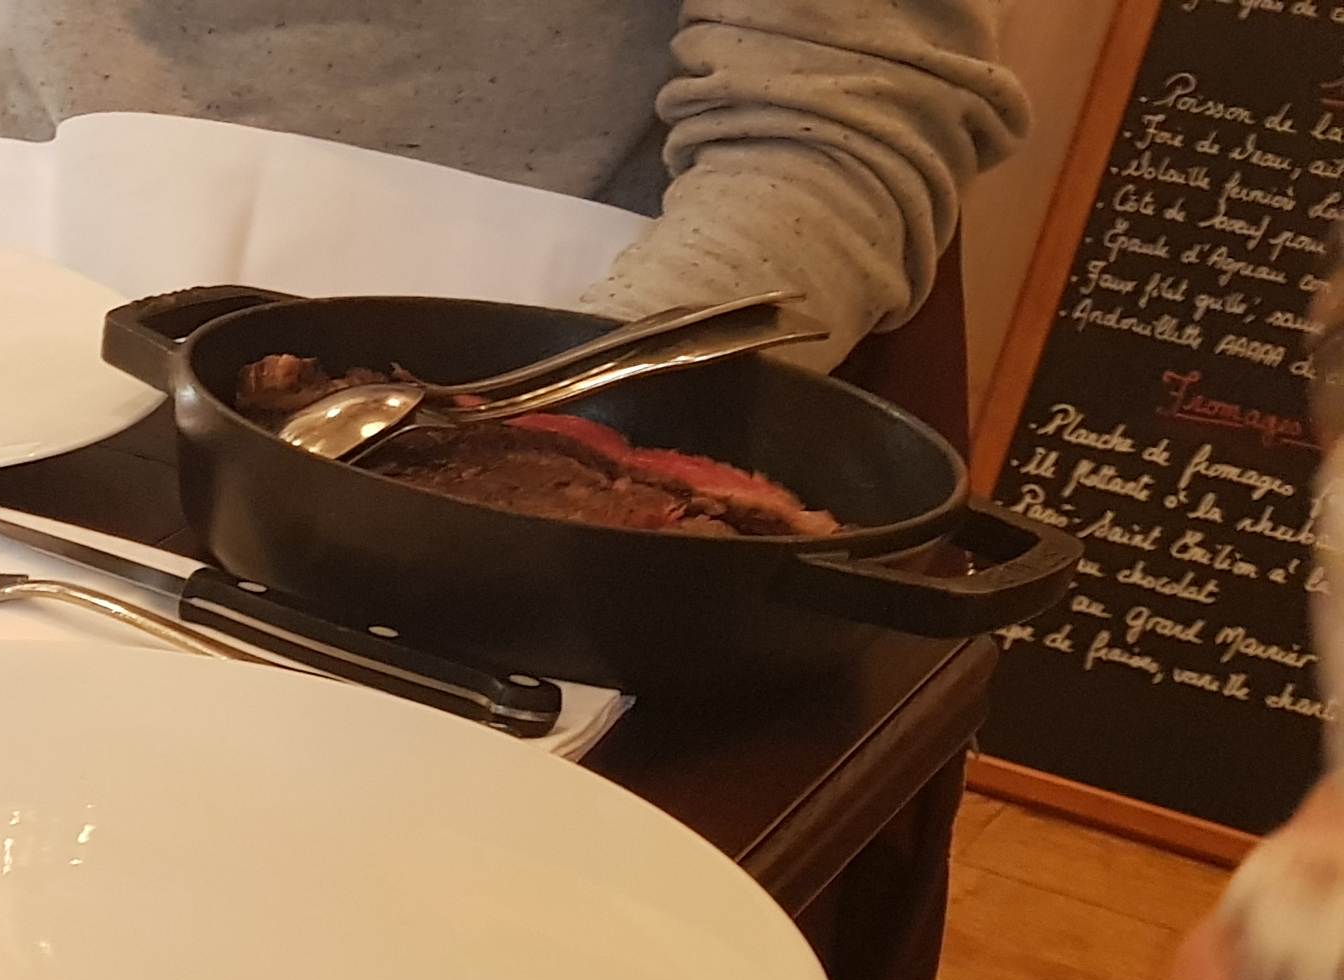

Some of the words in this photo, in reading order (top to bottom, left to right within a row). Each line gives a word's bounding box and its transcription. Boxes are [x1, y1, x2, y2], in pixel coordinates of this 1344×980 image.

[1153, 73, 1256, 126] Poisson
[1264, 103, 1297, 132] de
[1036, 404, 1136, 452] Planche
[1141, 438, 1170, 466] de
[1116, 560, 1219, 604] chocolat
[1043, 624, 1075, 654] de
